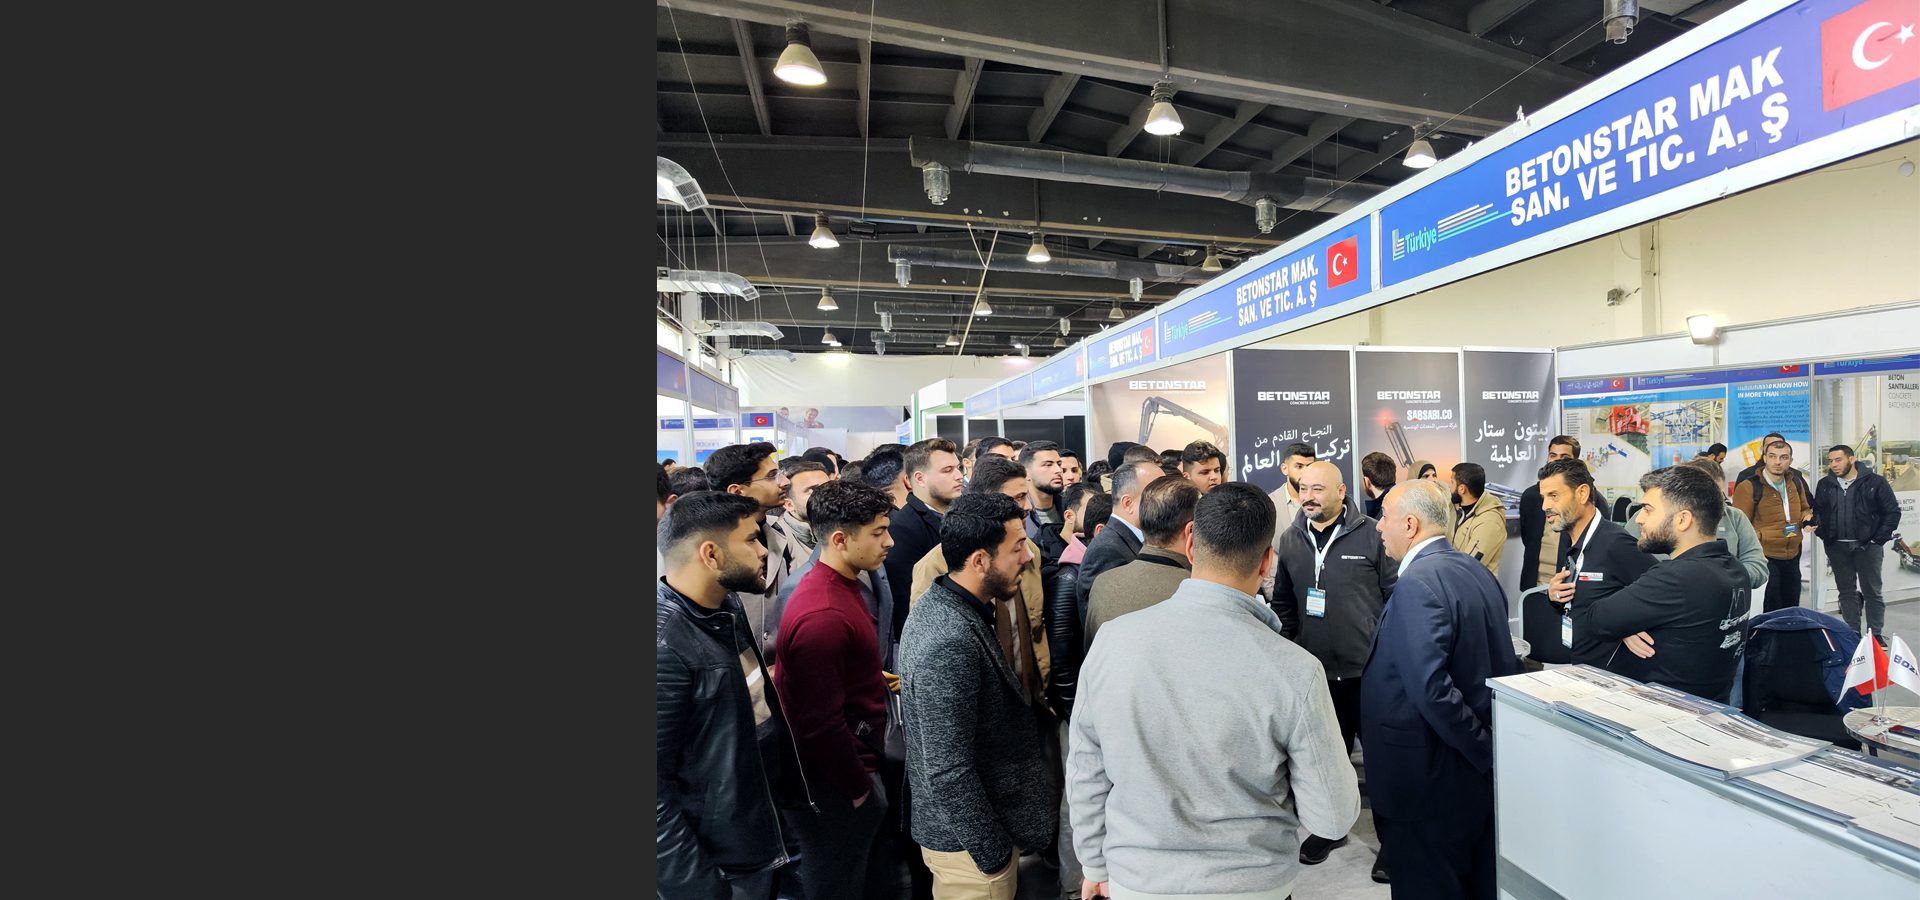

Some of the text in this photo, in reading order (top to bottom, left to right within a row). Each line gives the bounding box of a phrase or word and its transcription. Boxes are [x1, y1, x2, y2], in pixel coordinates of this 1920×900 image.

[1506, 47, 1784, 197] BETONSTAR MAK
[1511, 92, 1789, 226] SAN. VE TIC. A. Ş
[1405, 227, 1437, 254] Türkiye
[1236, 254, 1319, 306] BETONSTAR MAK.
[1239, 280, 1317, 327] SAN. VE TIC. A. Ş
[1129, 380, 1206, 390] BETONSTAR
[1257, 391, 1330, 401] BETONSTAR
[1376, 390, 1441, 400] BETONSTAR
[1482, 390, 1539, 400] BETONSTAR
[1406, 409, 1453, 421] SABSABI.CO
[1254, 424, 1332, 448] النجاح القادم من
[1474, 420, 1505, 442] ستار
[1514, 421, 1549, 441] بيتون
[1242, 437, 1350, 482] تركيا العالم
[1490, 444, 1536, 468] العالمية
